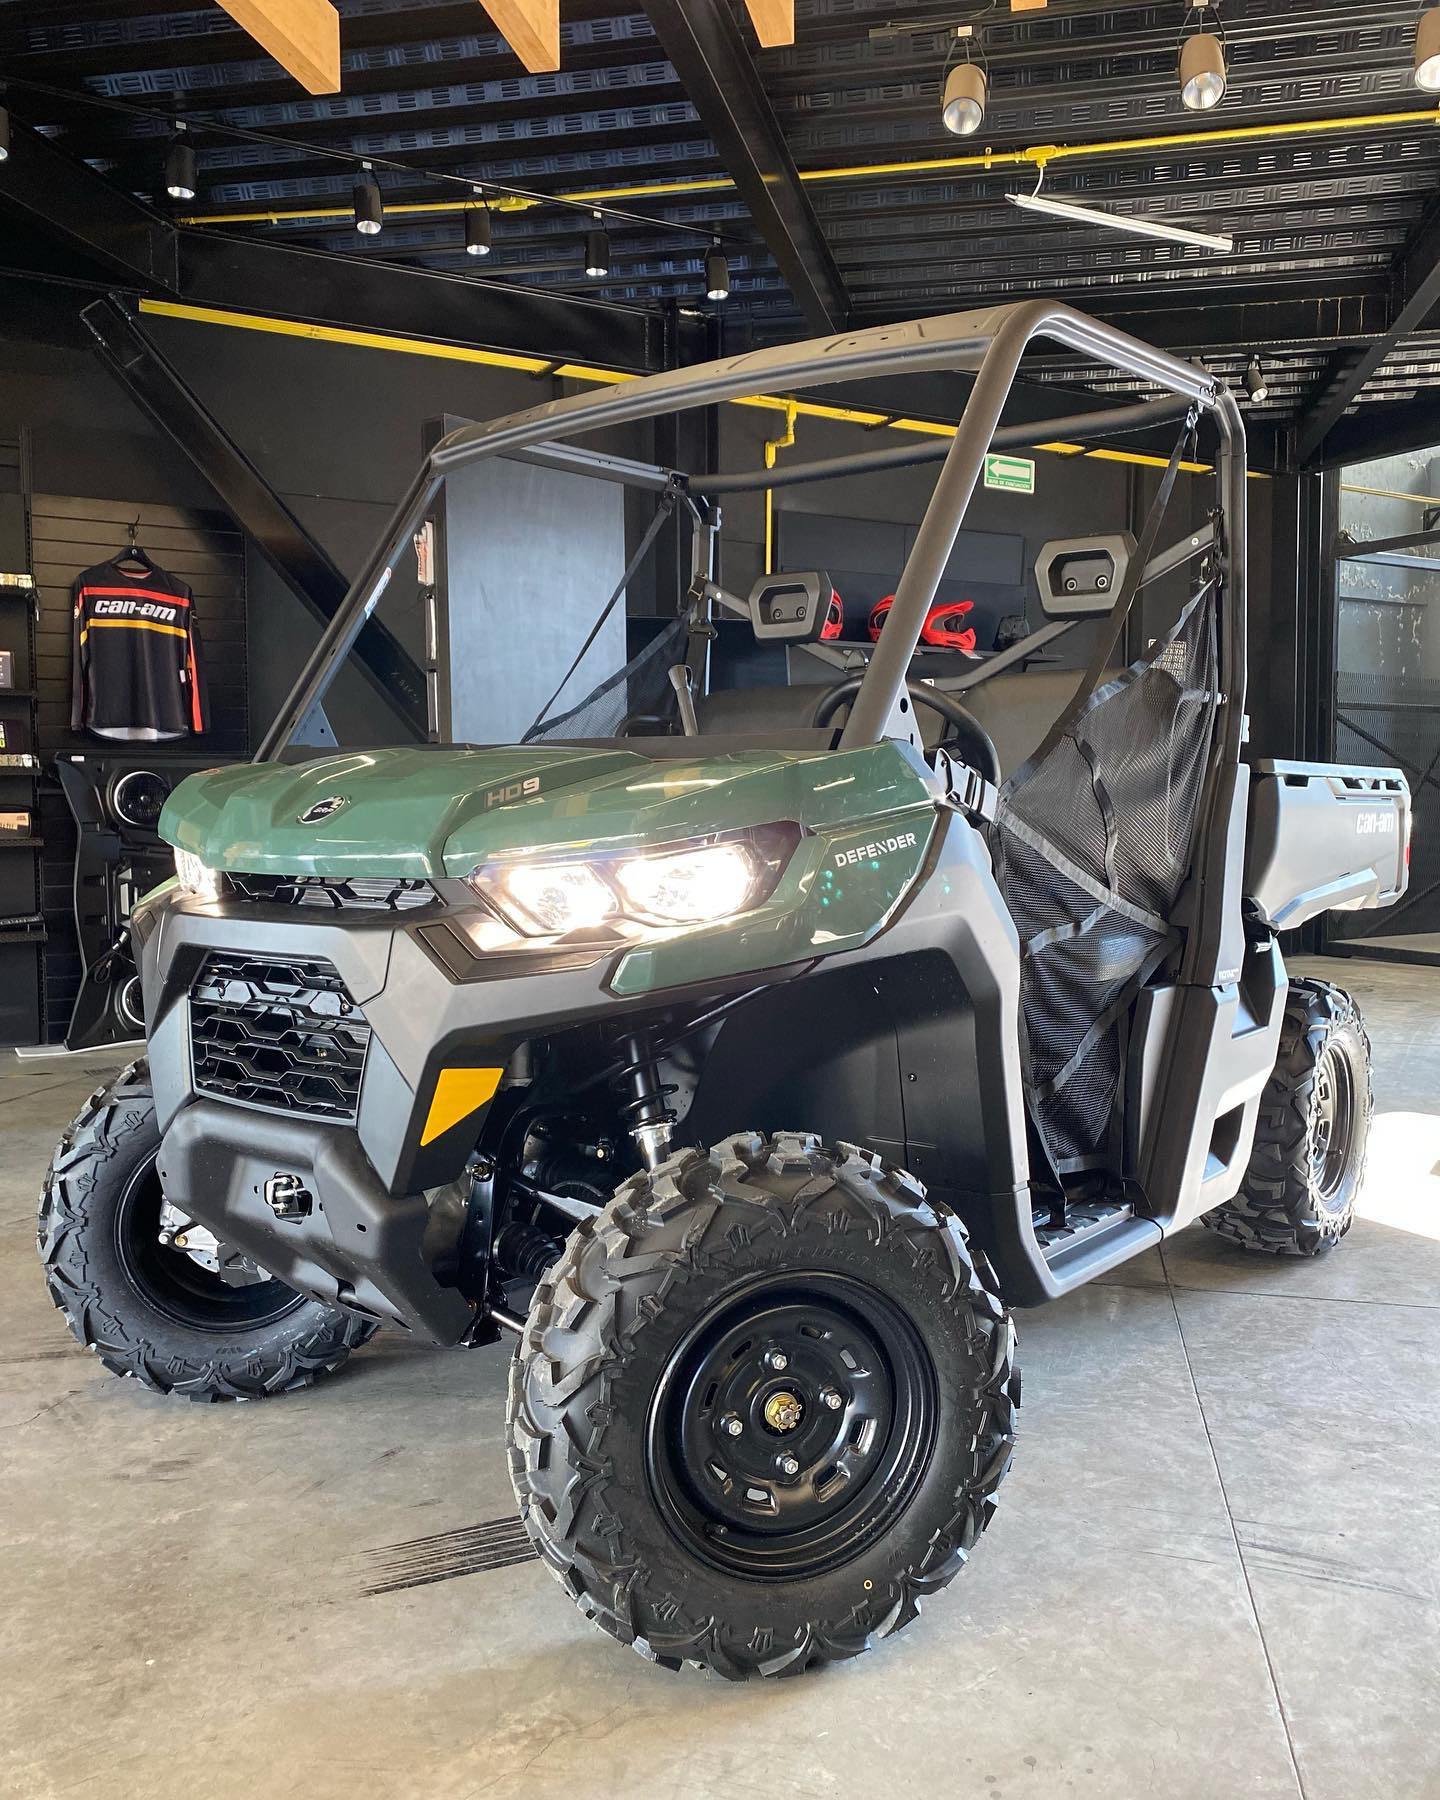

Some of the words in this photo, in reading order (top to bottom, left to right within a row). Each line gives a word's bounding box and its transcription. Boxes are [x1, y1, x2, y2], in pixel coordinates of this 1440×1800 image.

[95, 600, 176, 620] can-am
[486, 777, 539, 806] HD9
[1356, 812, 1394, 834] can-am
[834, 832, 917, 868] DEFENDER
